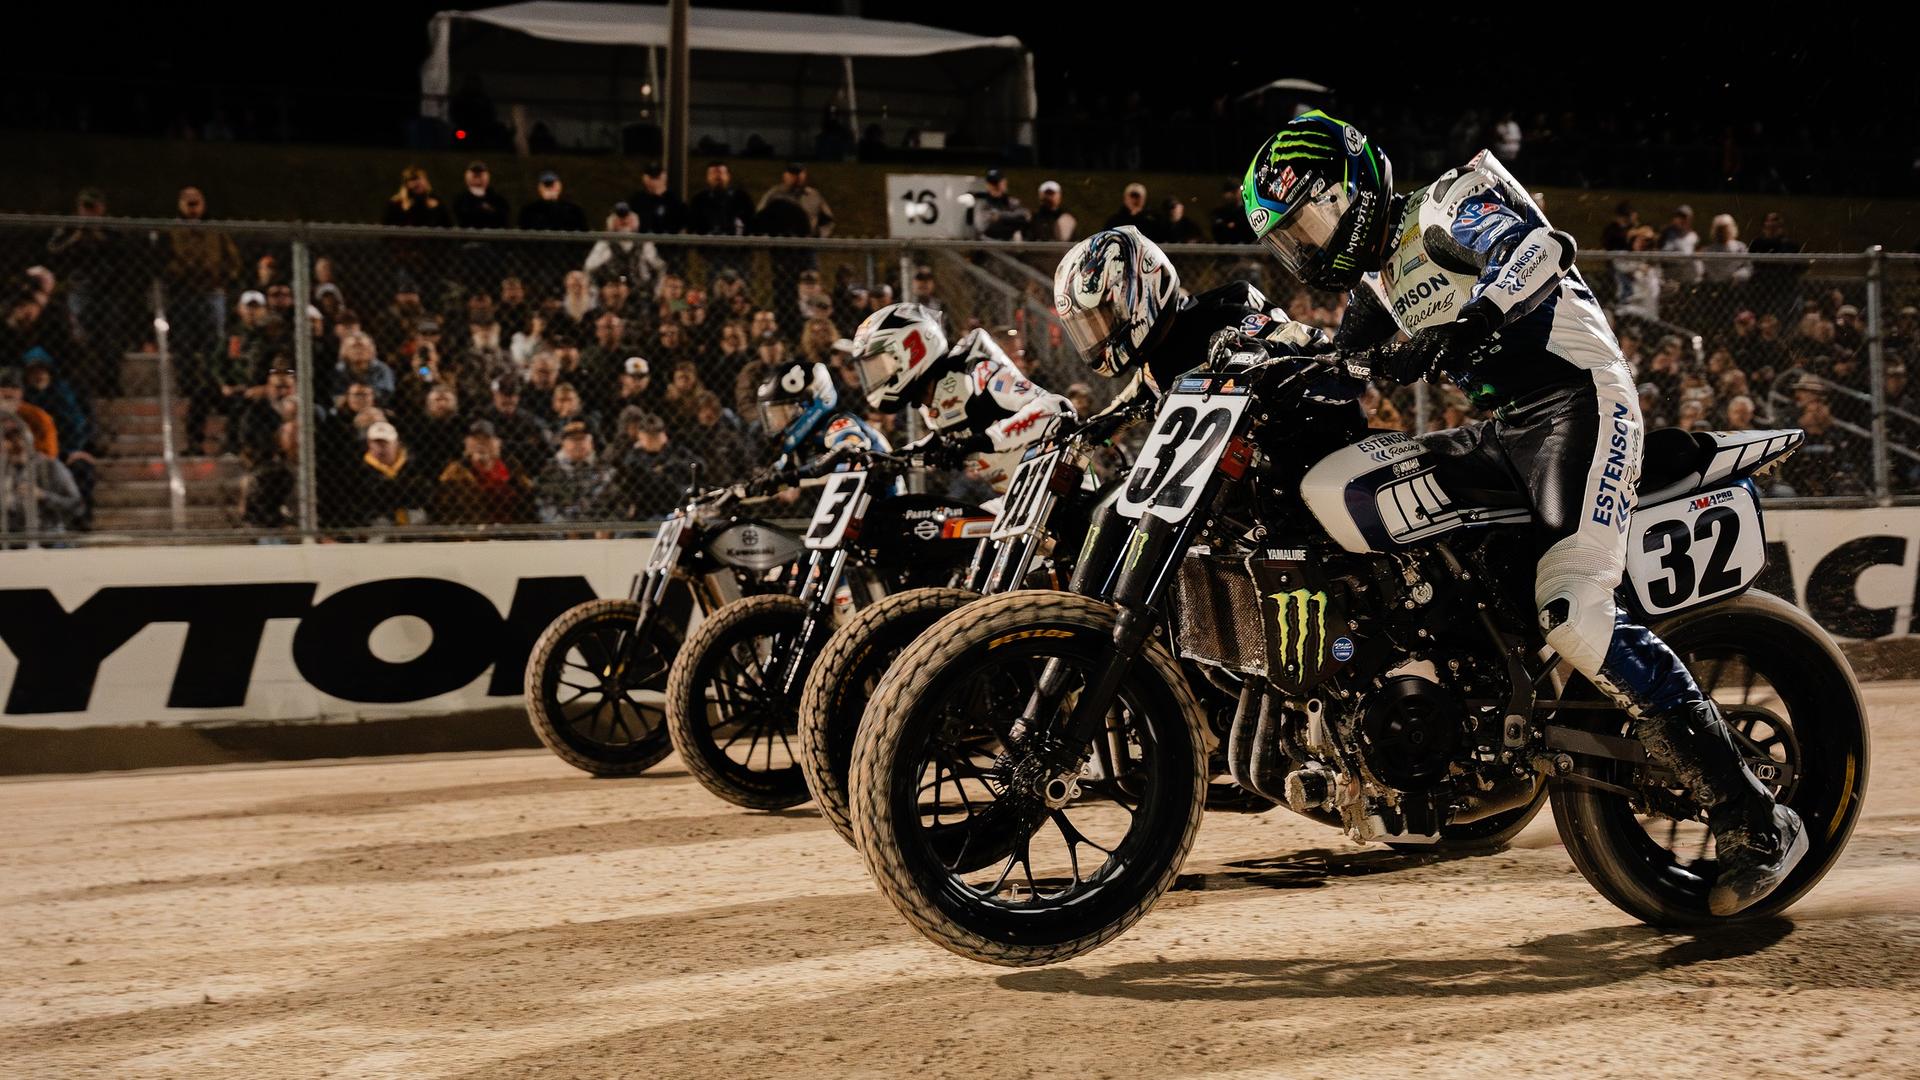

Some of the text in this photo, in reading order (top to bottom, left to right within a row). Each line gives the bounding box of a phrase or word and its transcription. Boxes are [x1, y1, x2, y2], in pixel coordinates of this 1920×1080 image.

[1495, 243, 1541, 290] ESTENSON
[1520, 249, 1548, 284] Racing
[902, 329, 927, 369] 3
[1126, 406, 1232, 509] 32
[1388, 443, 1421, 458] Racing
[1592, 402, 1629, 527] ESTENSON
[809, 478, 860, 541] 3
[1687, 490, 1733, 513] AMA PRO
[1642, 505, 1742, 609] 32
